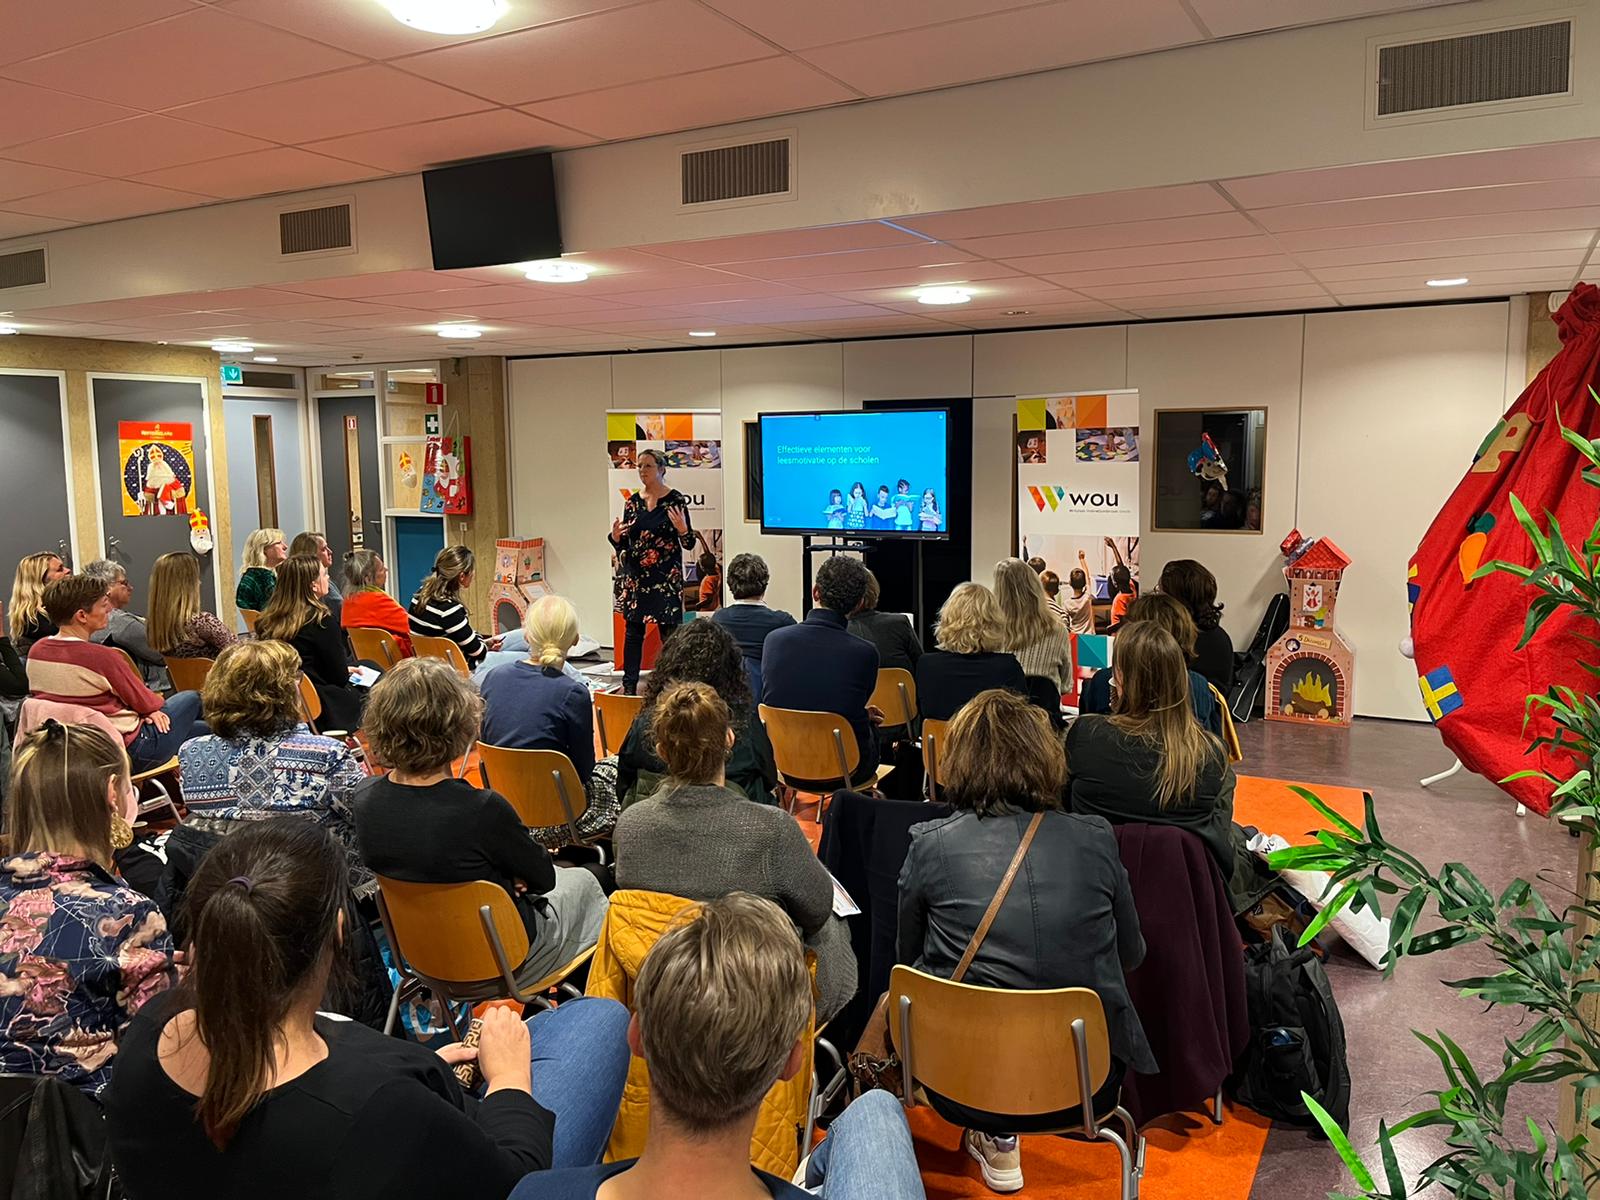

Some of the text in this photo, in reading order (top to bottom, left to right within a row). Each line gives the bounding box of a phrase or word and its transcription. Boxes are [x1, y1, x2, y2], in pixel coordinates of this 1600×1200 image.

[777, 445, 871, 454] Effectieve elementen voor
[777, 455, 880, 466] leesmotivatie op de scholen
[683, 494, 705, 506] ou
[1069, 493, 1119, 507] wou
